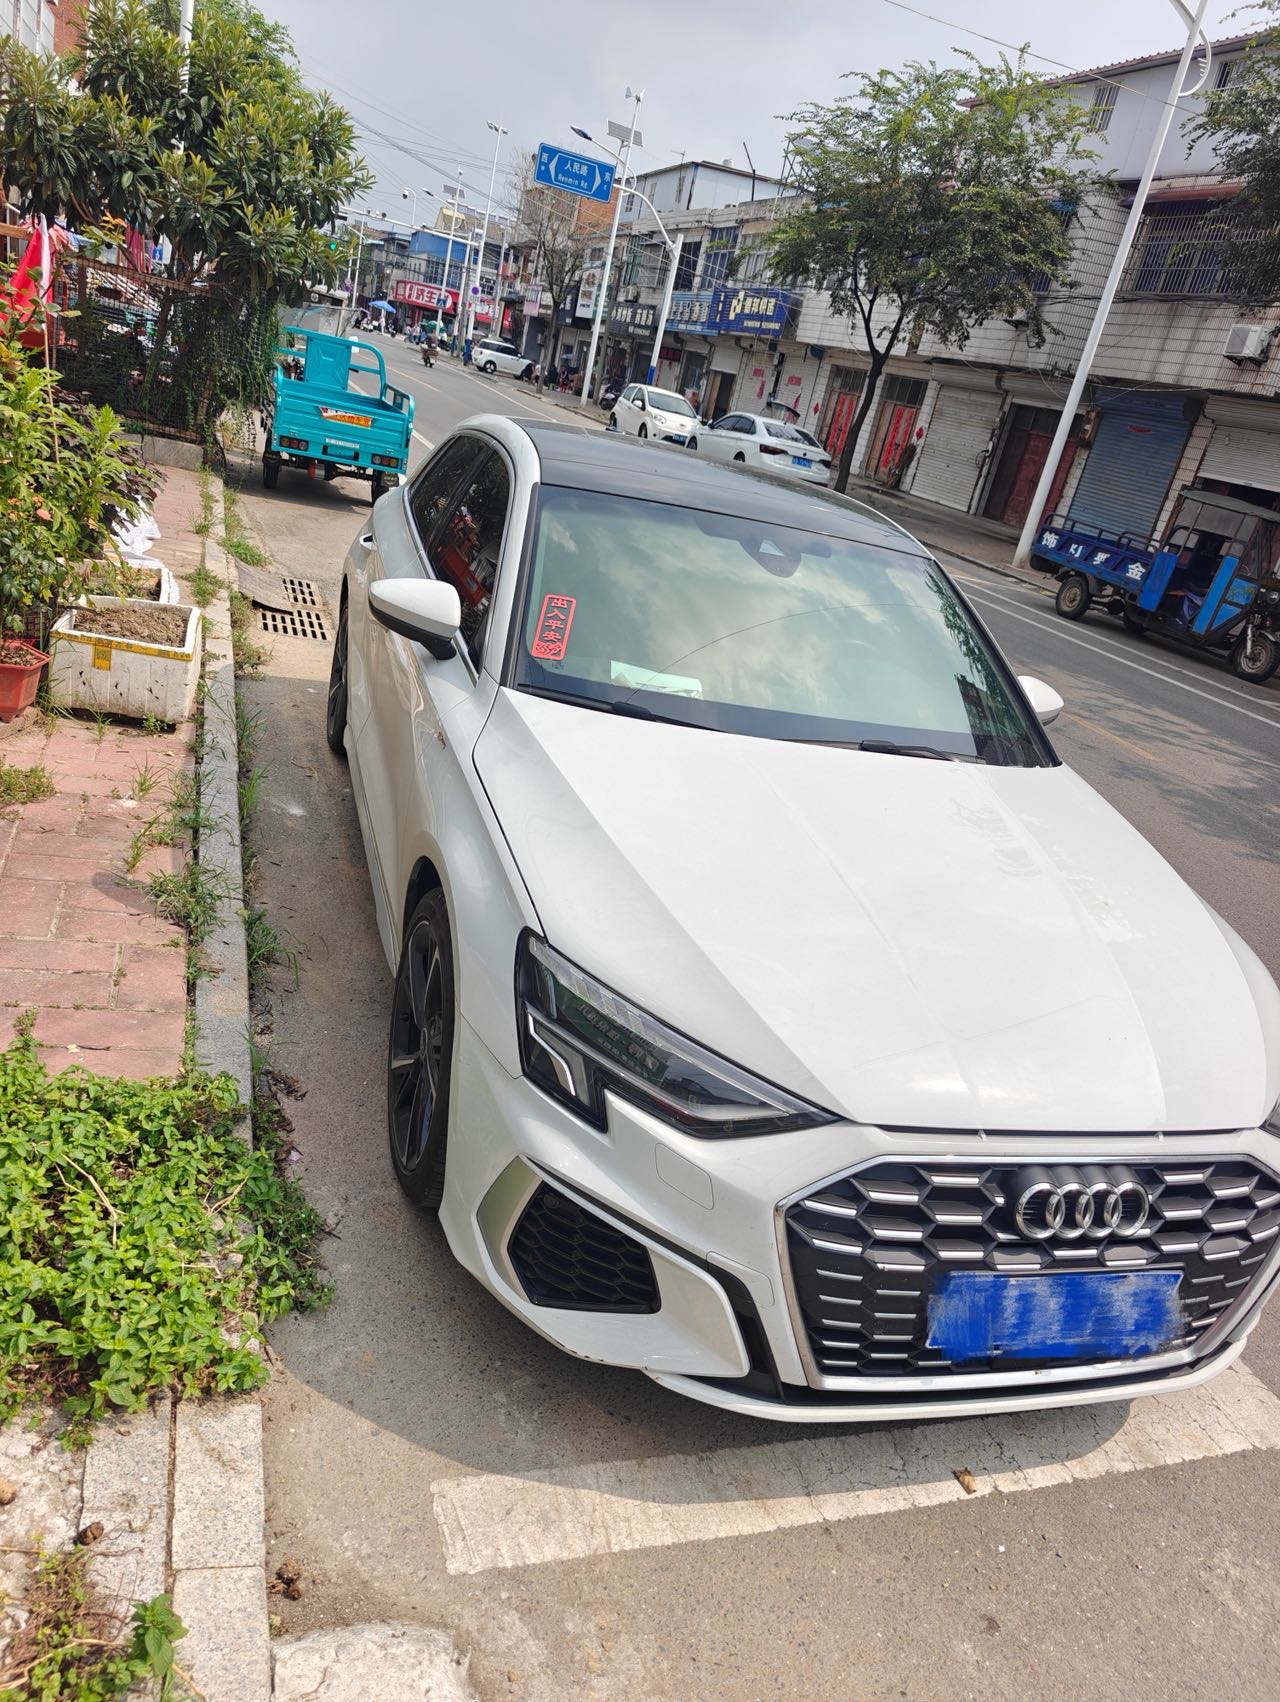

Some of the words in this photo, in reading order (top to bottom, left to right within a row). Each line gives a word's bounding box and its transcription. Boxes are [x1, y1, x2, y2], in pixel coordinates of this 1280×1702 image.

[541, 152, 549, 163] 西
[564, 160, 589, 176] 人民路
[558, 173, 579, 186] Renmin
[603, 172, 612, 182] 东
[542, 598, 568, 642] 出入平安
